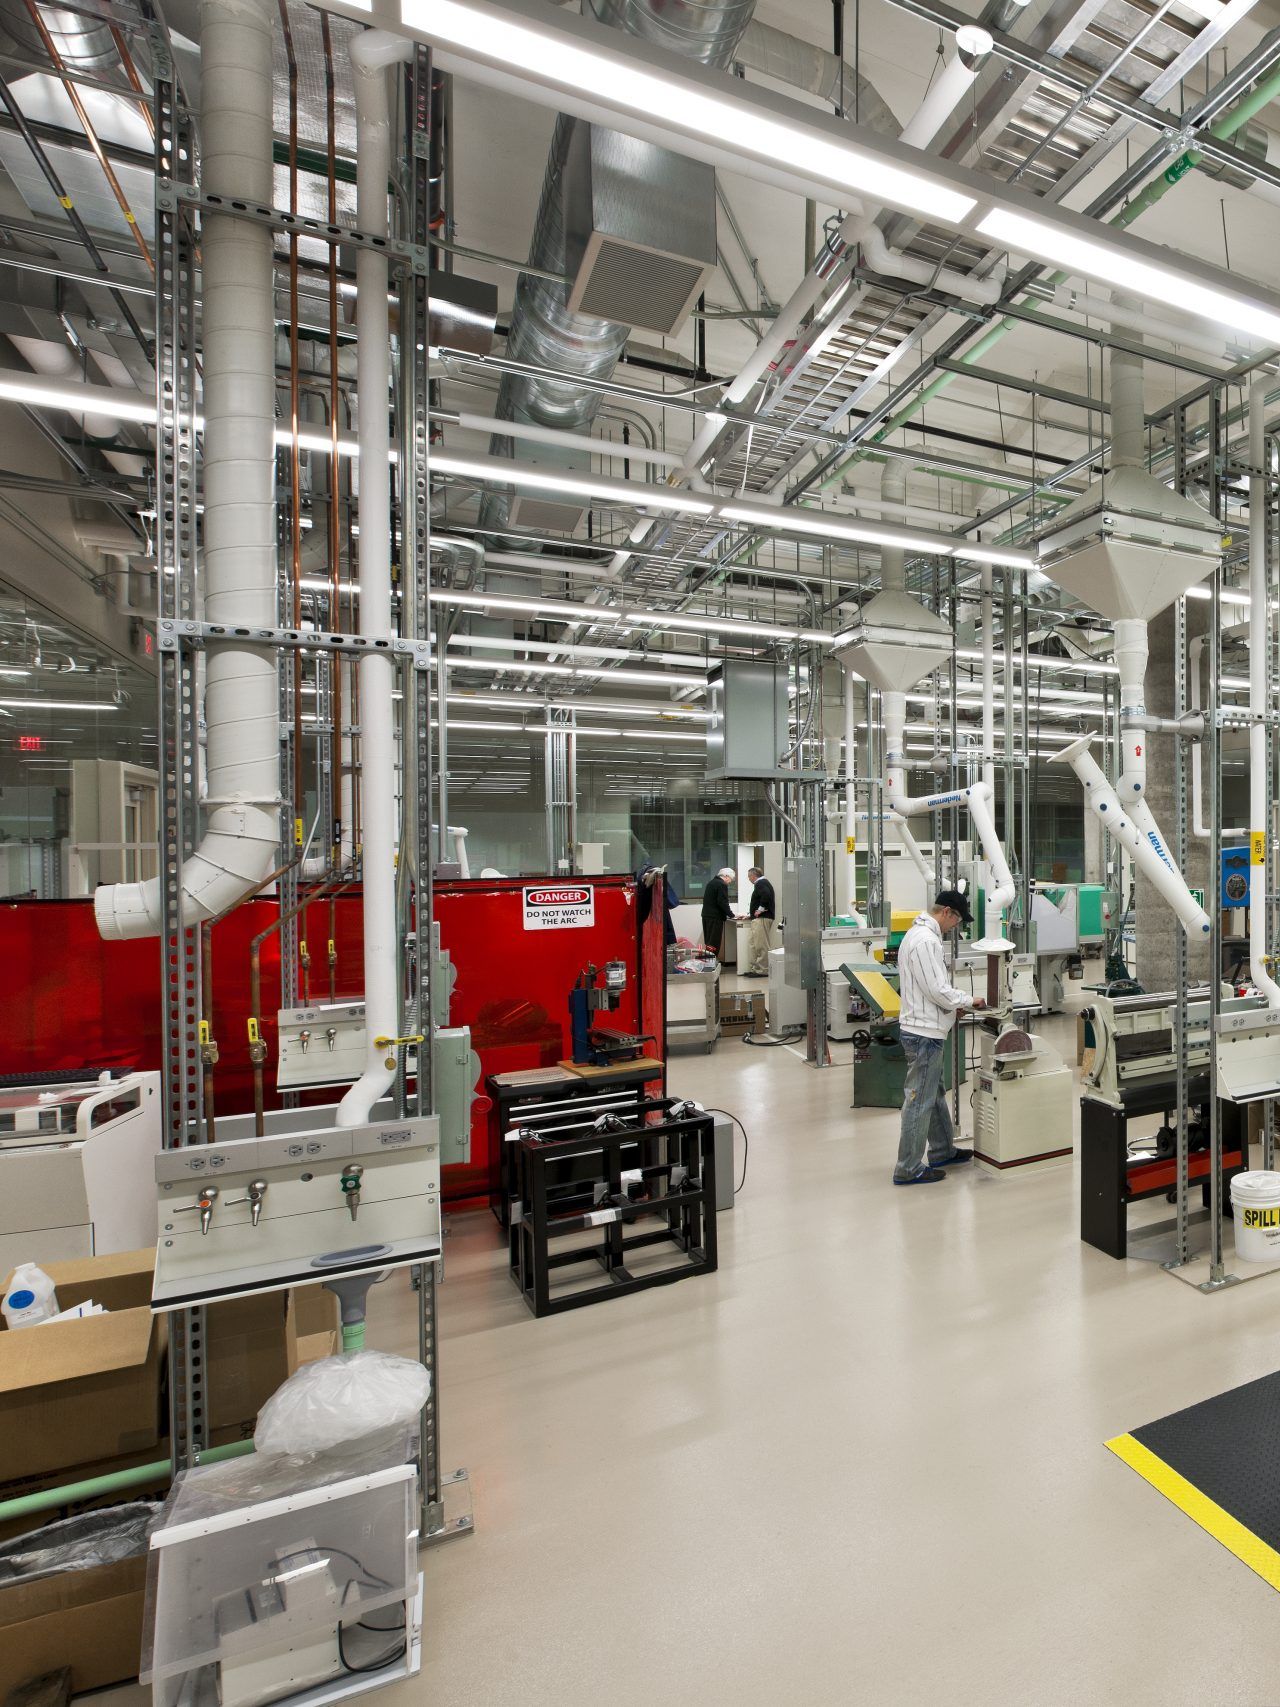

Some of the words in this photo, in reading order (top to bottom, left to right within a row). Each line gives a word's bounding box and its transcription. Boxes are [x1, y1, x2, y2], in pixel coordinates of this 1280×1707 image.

[927, 794, 961, 807] Nederman
[535, 892, 582, 902] DANGER
[561, 908, 591, 916] WATCH
[1244, 1208, 1276, 1227] SPILL
